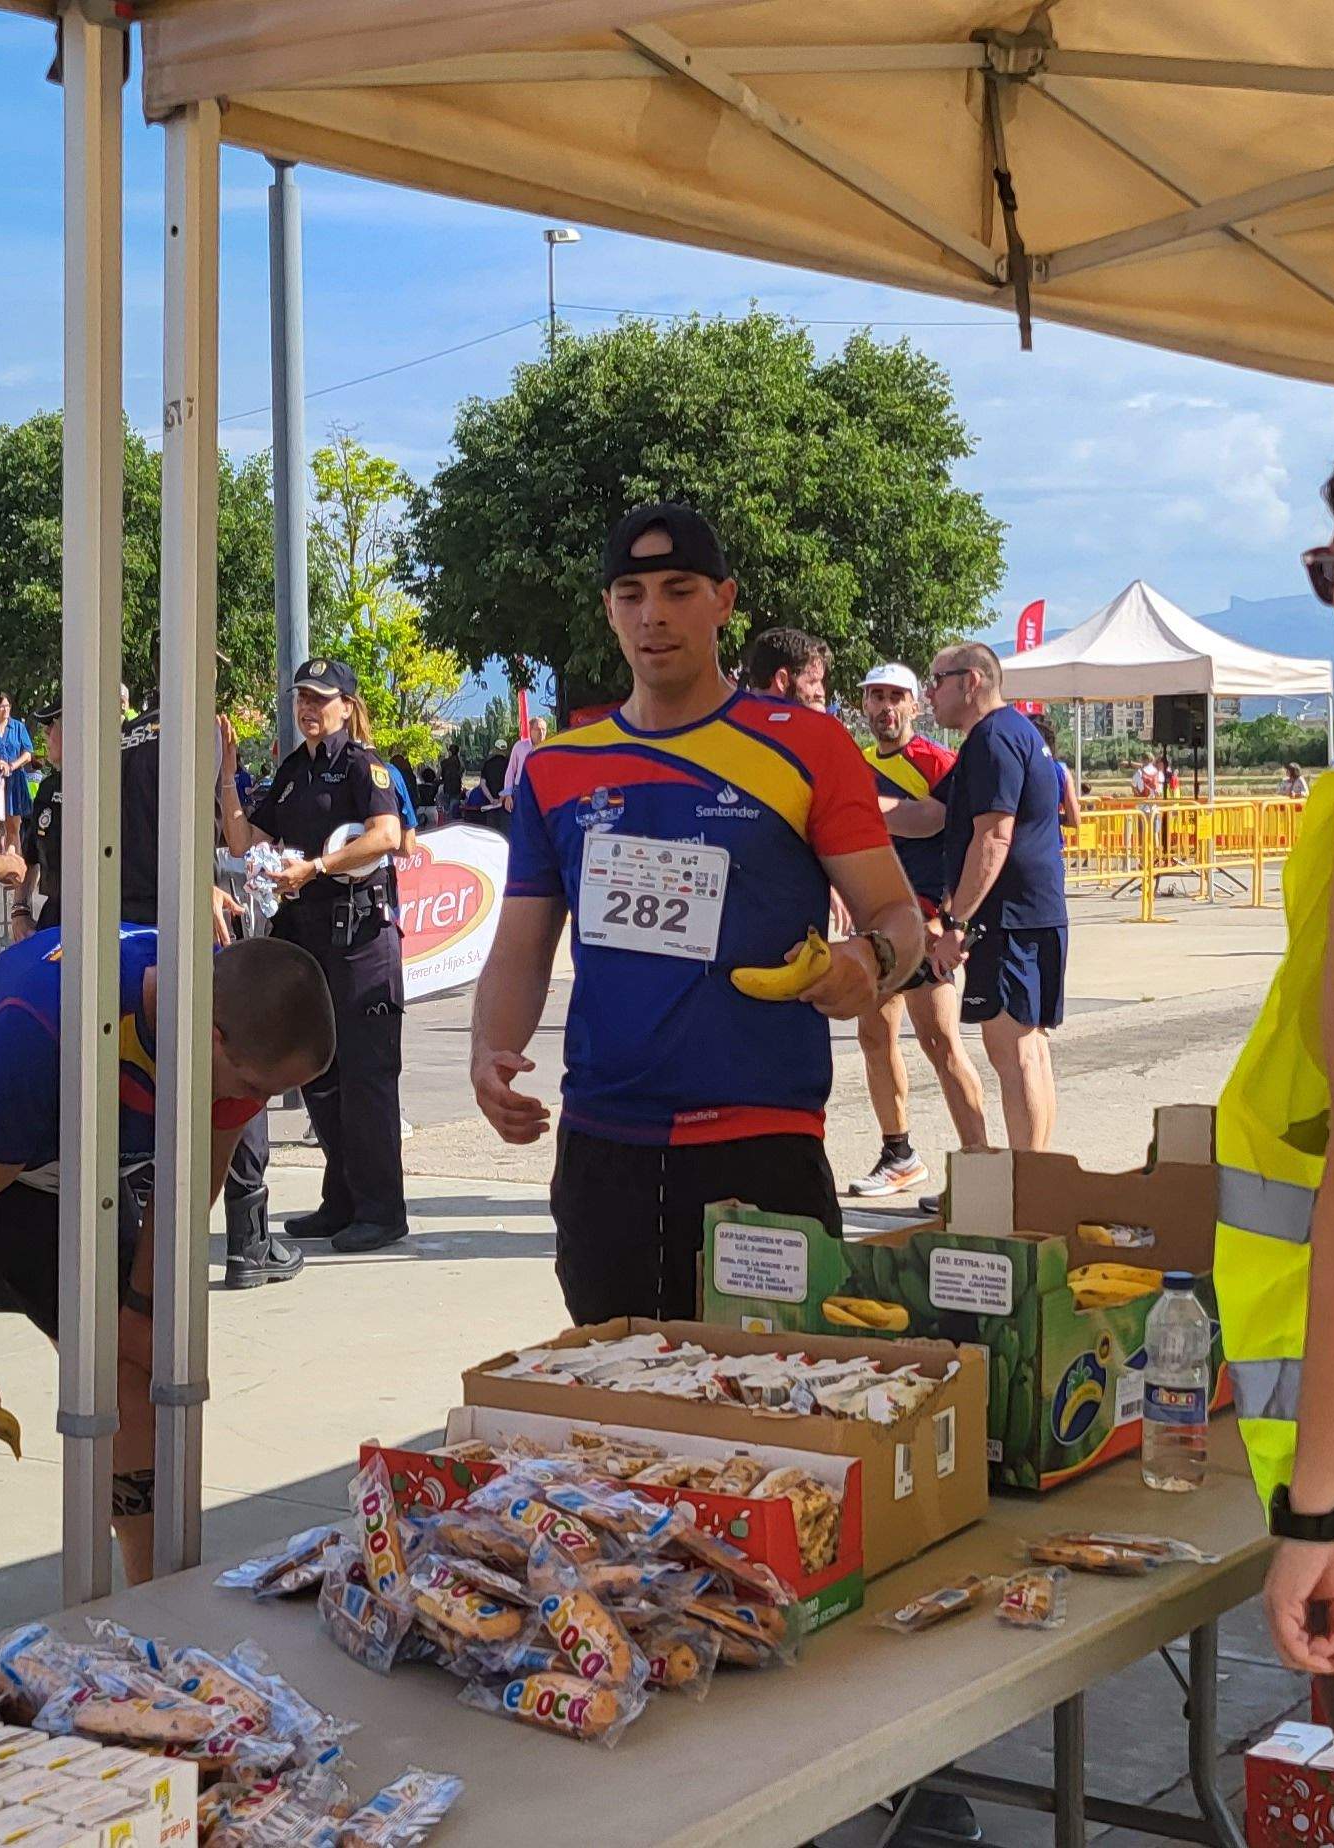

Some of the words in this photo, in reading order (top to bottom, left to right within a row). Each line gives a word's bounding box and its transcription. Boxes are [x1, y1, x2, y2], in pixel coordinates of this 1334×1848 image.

[695, 804, 761, 820] Santander
[603, 890, 690, 934] 282
[442, 955, 466, 974] Hijos
[954, 1257, 980, 1269] EXTRA
[509, 1497, 588, 1551] eboca
[539, 1594, 607, 1680] eboca
[503, 1677, 592, 1726] eboca
